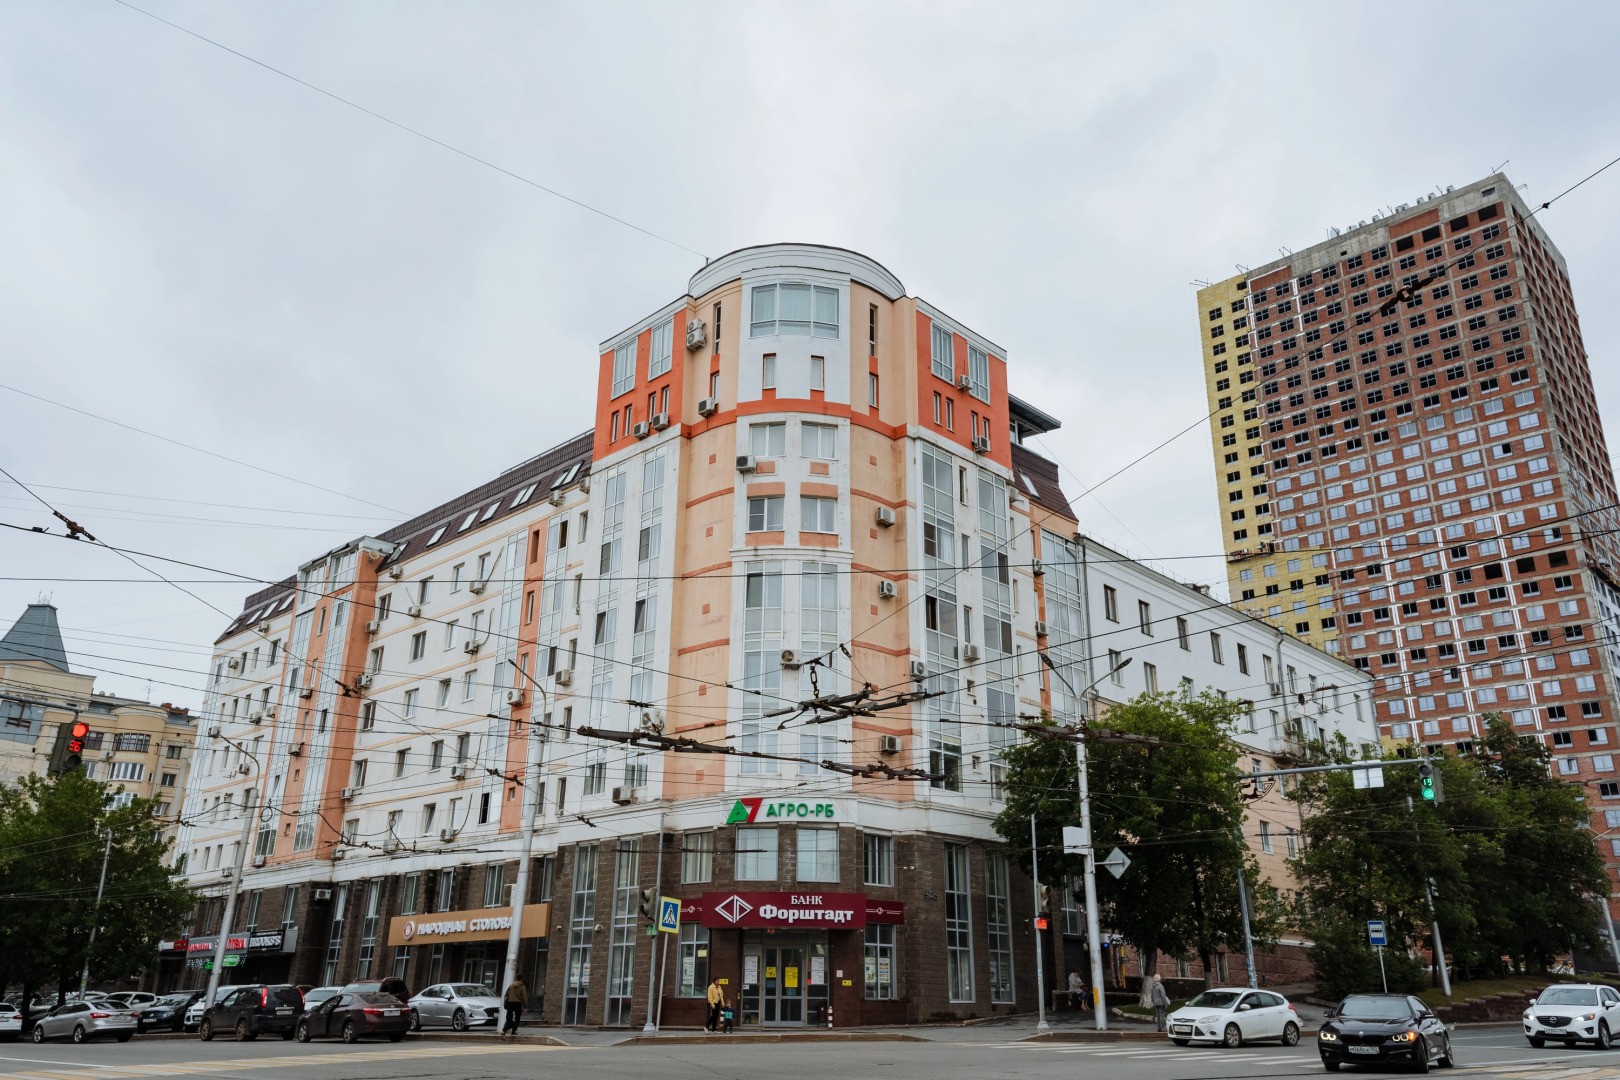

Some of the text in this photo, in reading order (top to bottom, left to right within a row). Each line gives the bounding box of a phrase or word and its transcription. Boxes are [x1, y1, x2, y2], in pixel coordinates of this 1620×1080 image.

[69, 740, 82, 752] 26
[1423, 778, 1432, 786] 19
[766, 803, 834, 818] АГРО-РБ
[791, 895, 823, 905] БАНК
[759, 904, 854, 923] Форштадт
[417, 920, 466, 935] НАРОДНАЯ
[469, 916, 513, 932] СТОЛОВА
